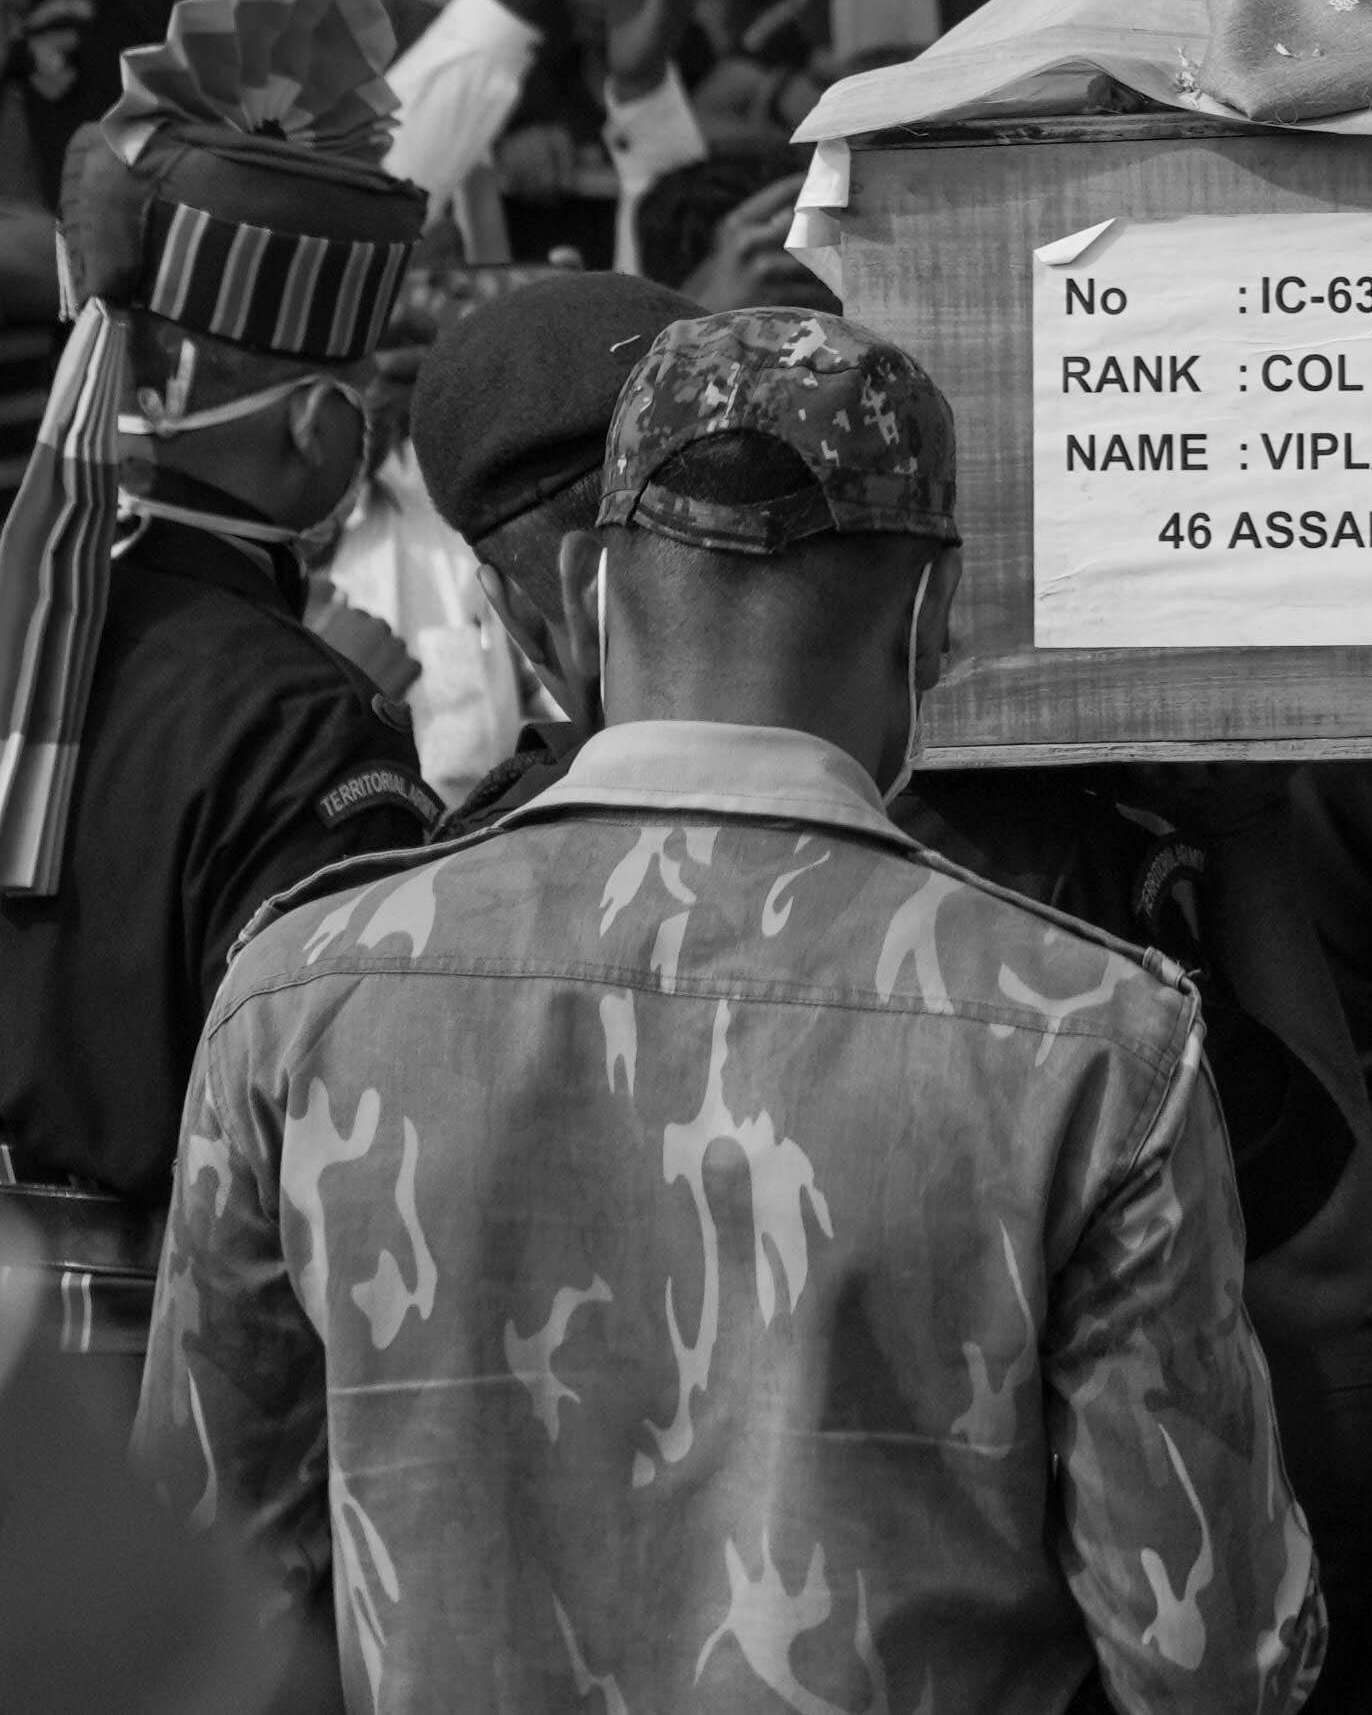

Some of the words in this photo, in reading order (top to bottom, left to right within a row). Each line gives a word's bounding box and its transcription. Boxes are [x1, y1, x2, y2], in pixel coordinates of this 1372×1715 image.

[1067, 279, 1126, 314] No
[1063, 356, 1200, 393] RANK
[1263, 354, 1363, 391] COL
[1068, 434, 1207, 471] NAME
[1159, 513, 1211, 549] 46
